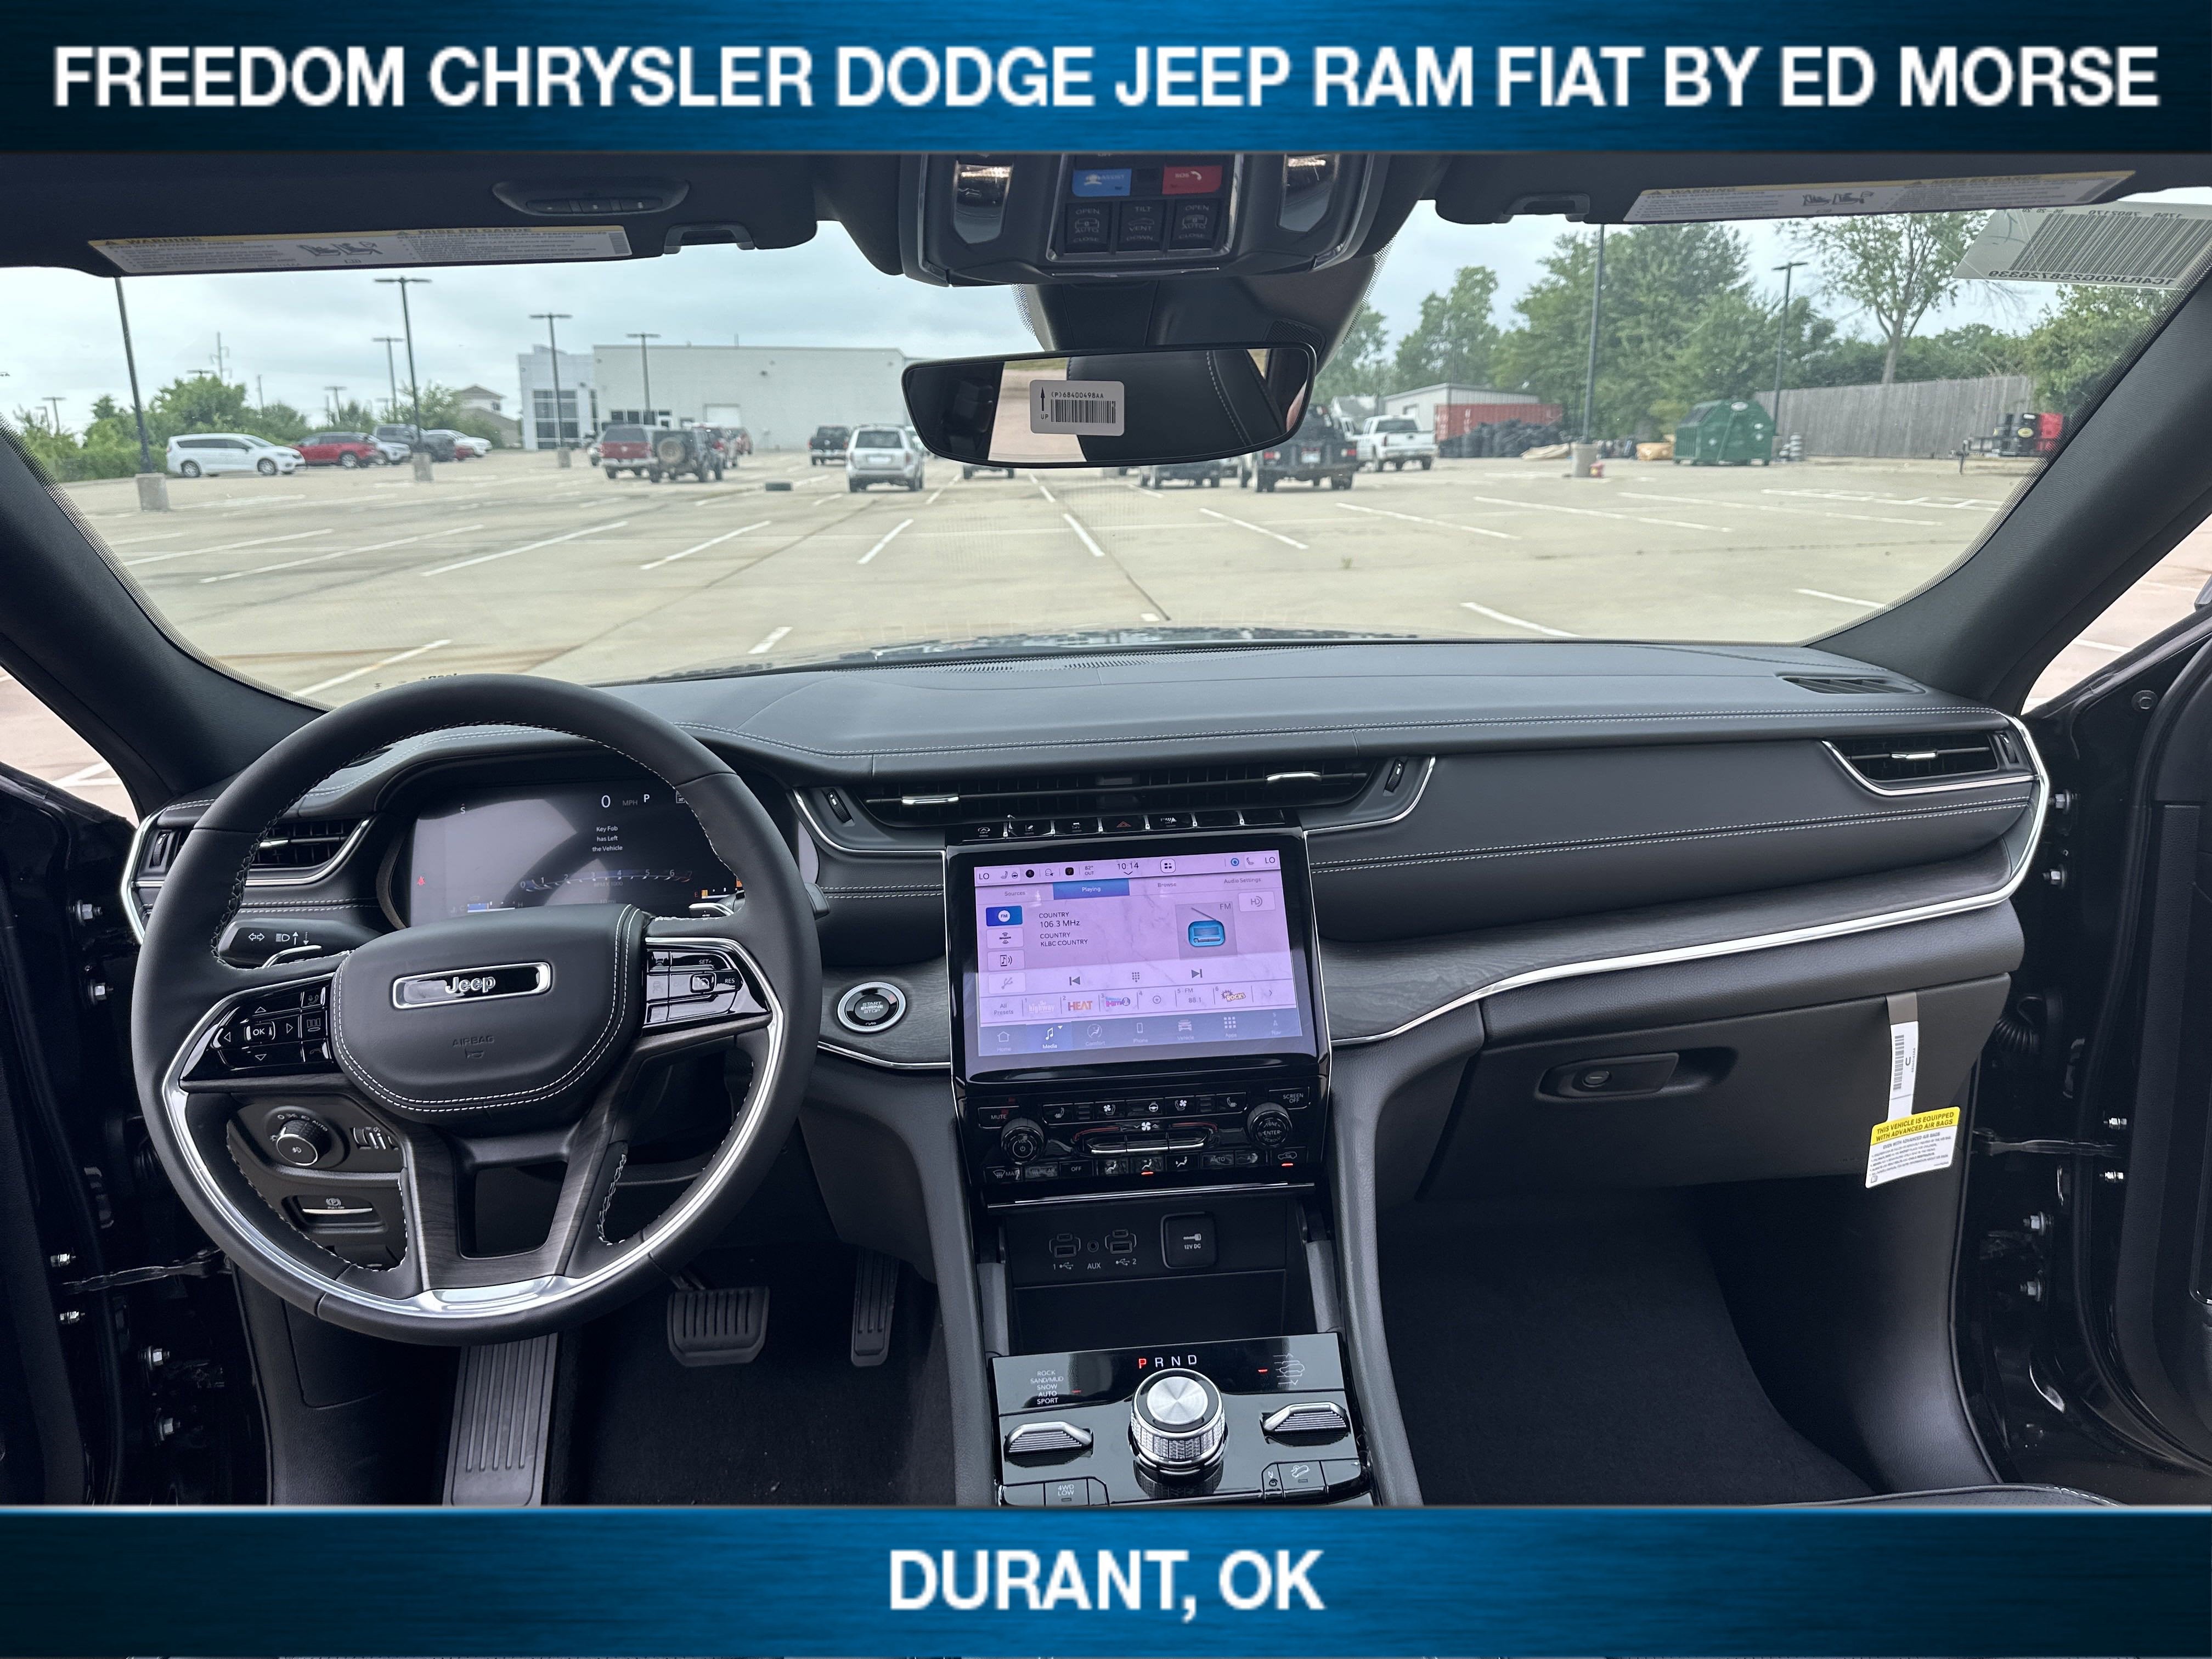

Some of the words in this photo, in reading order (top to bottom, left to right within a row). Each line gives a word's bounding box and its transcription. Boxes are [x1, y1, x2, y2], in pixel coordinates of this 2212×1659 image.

[601, 795, 611, 808] 0
[644, 794, 650, 803] P
[445, 976, 496, 994] Jeep
[1028, 1004, 1055, 1013] highway
[1068, 1001, 1093, 1011] HEAT
[252, 1028, 266, 1036] OK
[453, 1035, 495, 1047] AIRBAG
[312, 1120, 329, 1132] AUTO
[1877, 1125, 1889, 1135] THIS
[1890, 1119, 1914, 1131] VEHICLE
[1922, 1111, 1954, 1122] EQUIPPED
[1876, 1132, 1890, 1142] WITH
[1891, 1125, 1923, 1138] ADVANCED
[1936, 1119, 1953, 1127] BAGS
[1138, 1358, 1147, 1369] P
[1154, 1357, 1164, 1368] R
[1171, 1356, 1181, 1366] N
[1188, 1354, 1197, 1365] D
